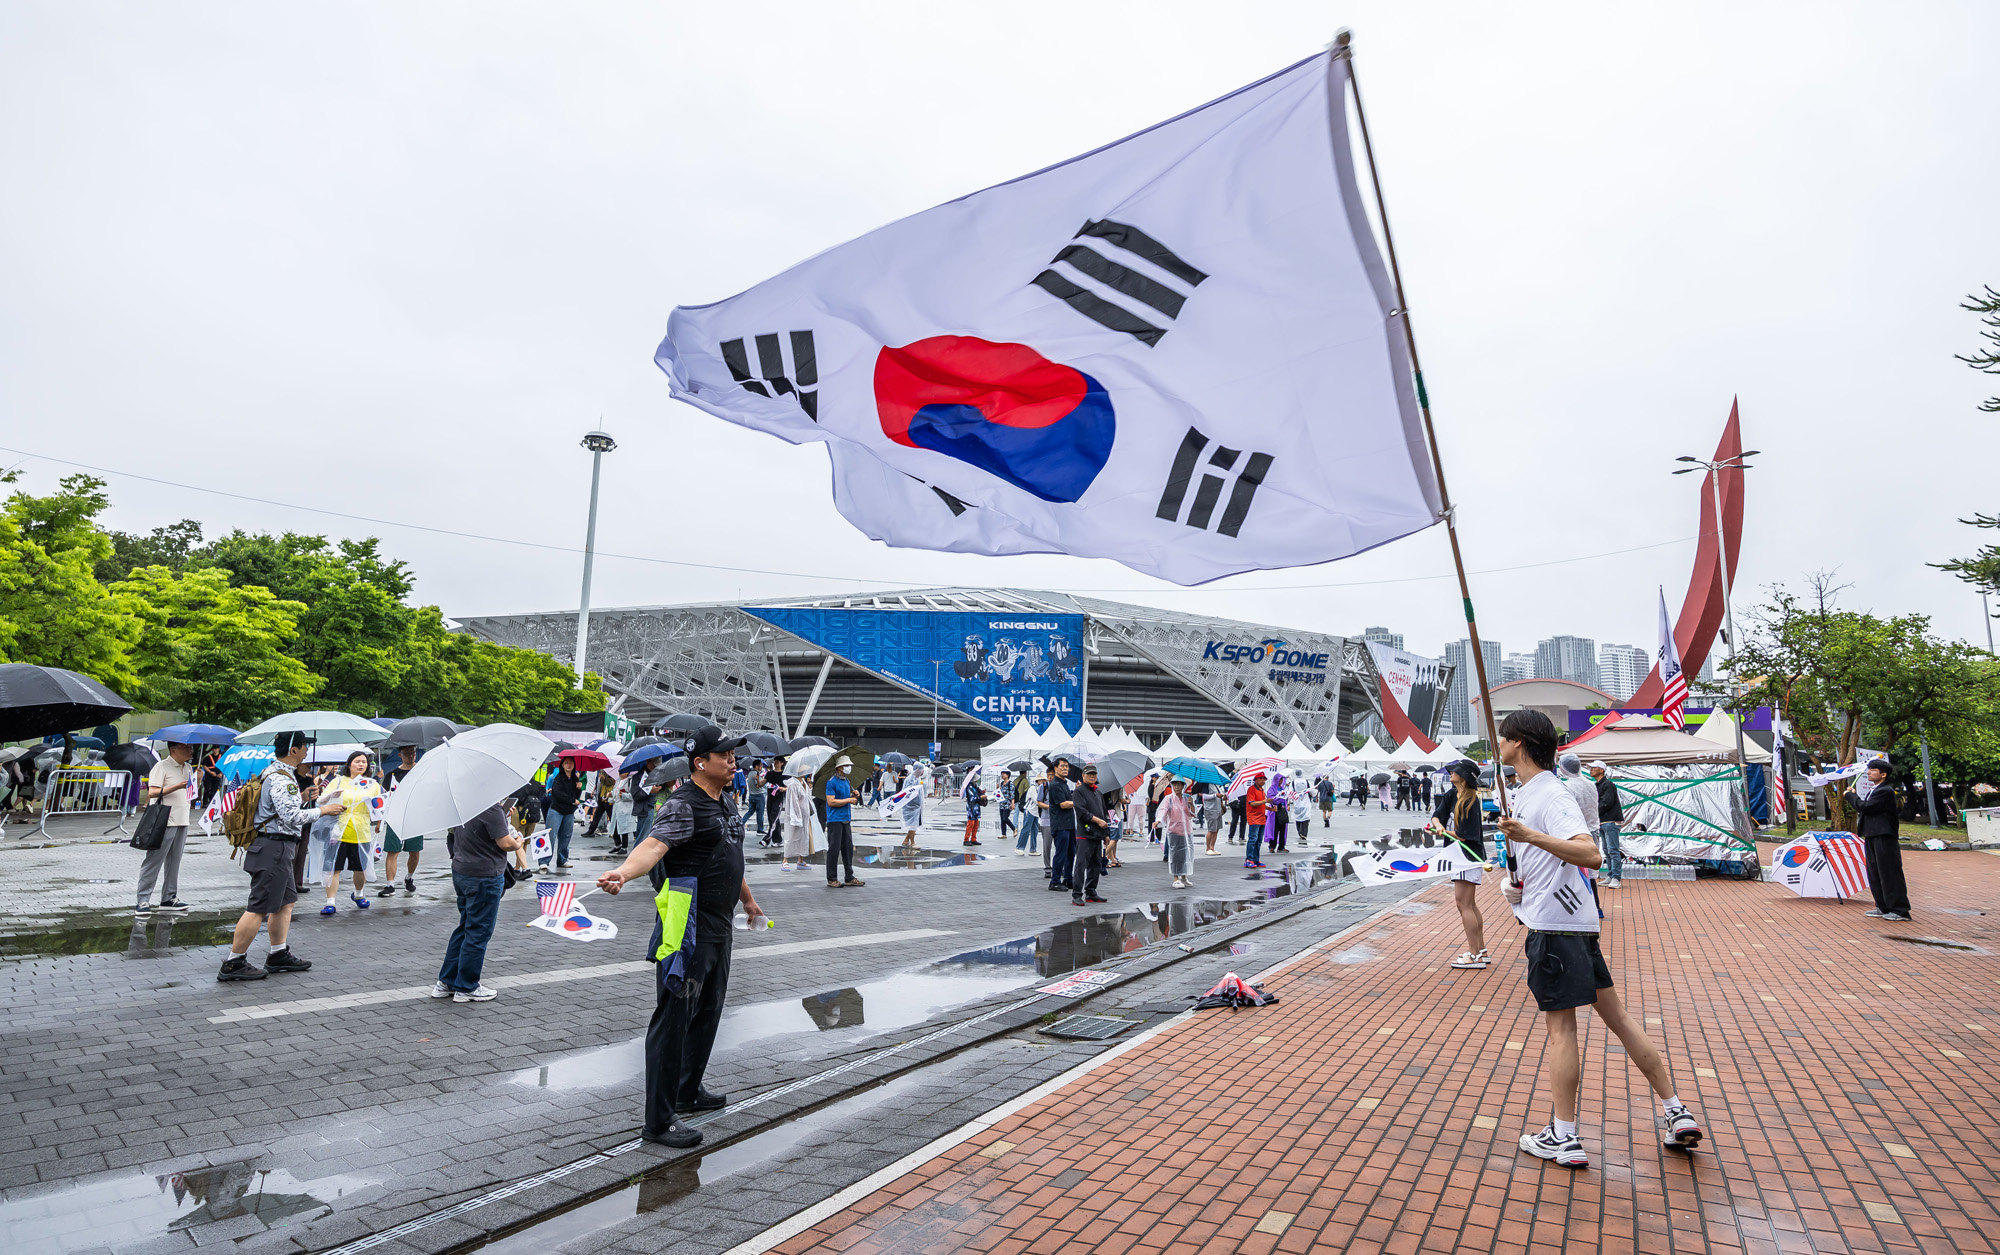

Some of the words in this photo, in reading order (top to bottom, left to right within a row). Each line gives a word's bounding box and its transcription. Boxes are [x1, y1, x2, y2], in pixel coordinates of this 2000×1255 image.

[988, 621, 1058, 630] KINGGNU
[1203, 640, 1265, 663] KSPO
[1271, 649, 1330, 669] DOME
[1268, 668, 1326, 684] 올림픽체조경기장
[1696, 752, 1729, 760] CYFIE
